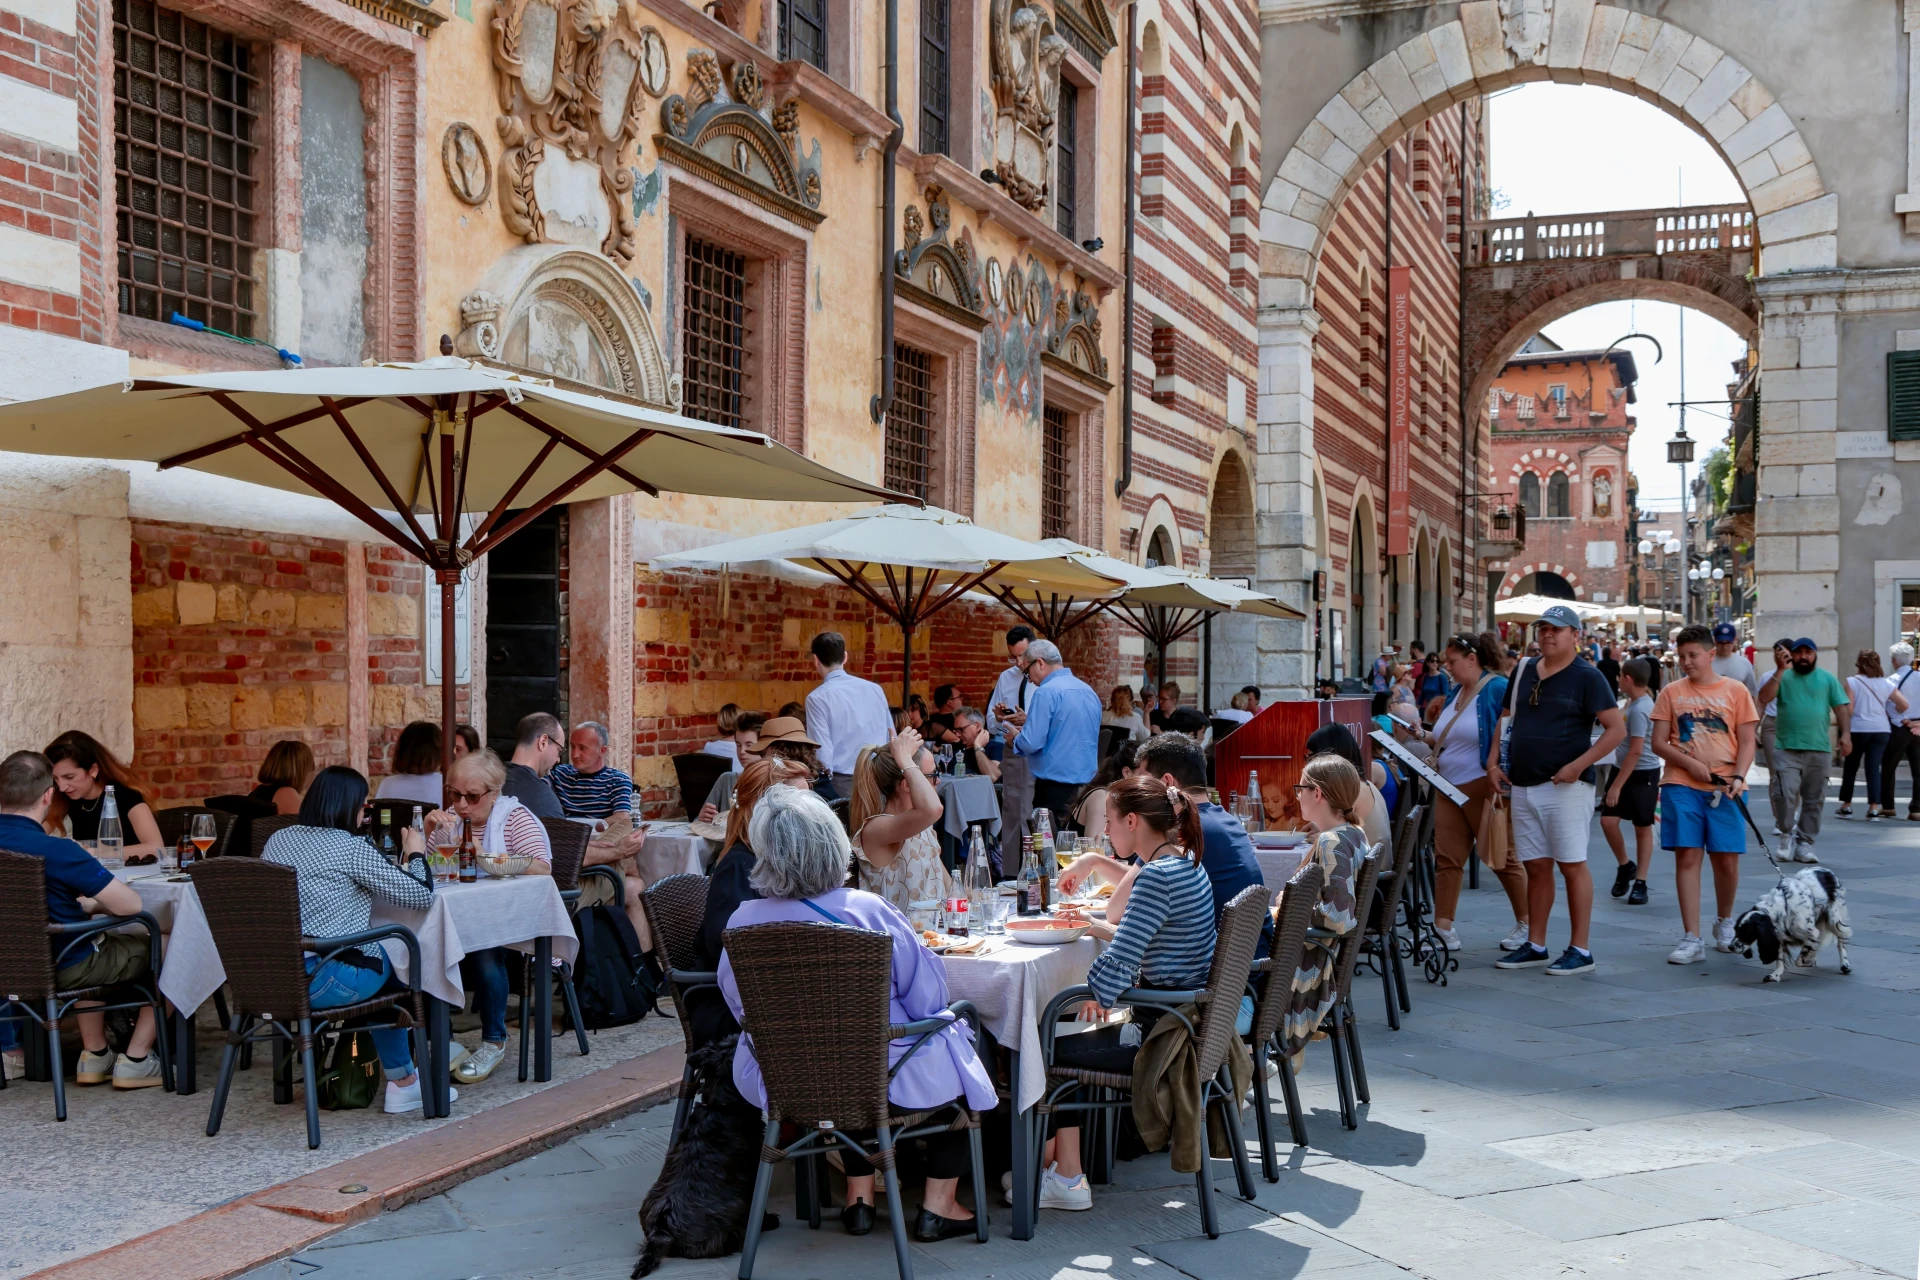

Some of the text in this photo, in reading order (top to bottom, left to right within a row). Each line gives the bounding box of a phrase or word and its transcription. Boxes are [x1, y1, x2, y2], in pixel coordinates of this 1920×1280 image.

[1396, 293, 1406, 427] PALAZZO della RAGIONE
